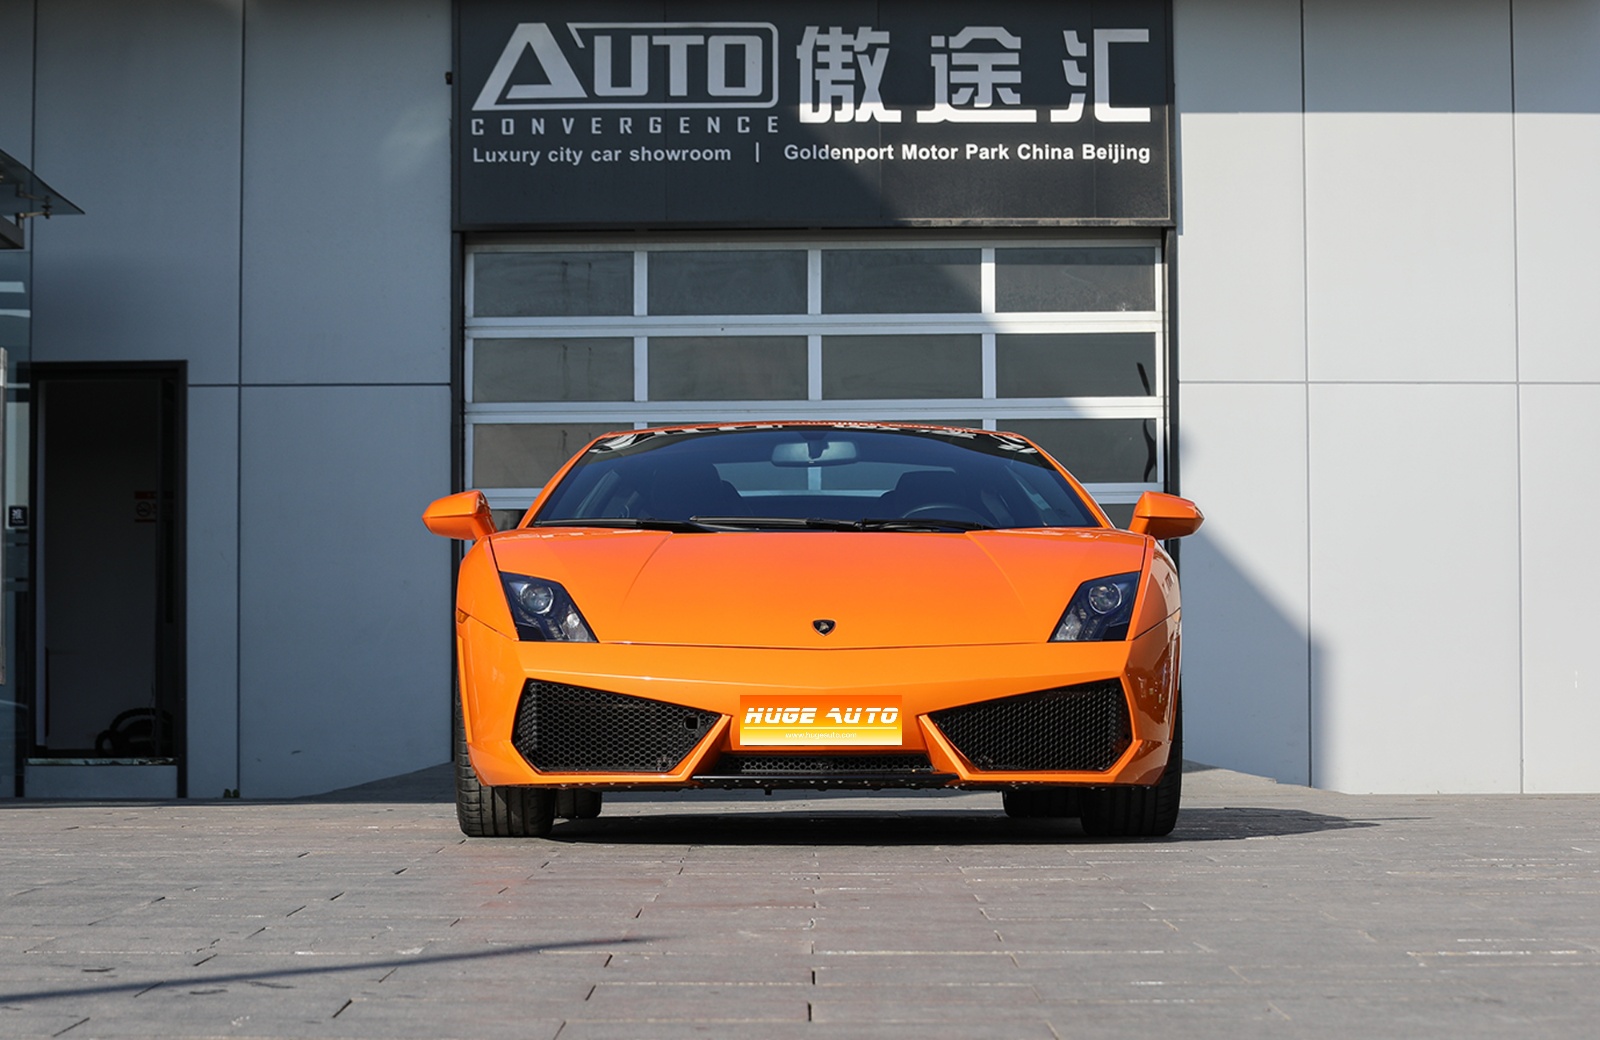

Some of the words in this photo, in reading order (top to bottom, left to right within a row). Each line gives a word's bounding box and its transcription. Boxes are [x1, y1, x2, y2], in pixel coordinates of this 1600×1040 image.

[471, 22, 765, 111] AUTO
[796, 26, 1152, 123] 傲途汇
[471, 116, 779, 135] CONVERGENCE
[472, 148, 540, 166] Luxury
[547, 147, 583, 165] city
[591, 148, 622, 161] car
[629, 146, 732, 161] showroom
[783, 144, 894, 163] Goldenport
[901, 144, 958, 160] Motor
[965, 144, 1010, 160] Park
[1016, 144, 1074, 160] China
[1081, 143, 1151, 163] Beijing
